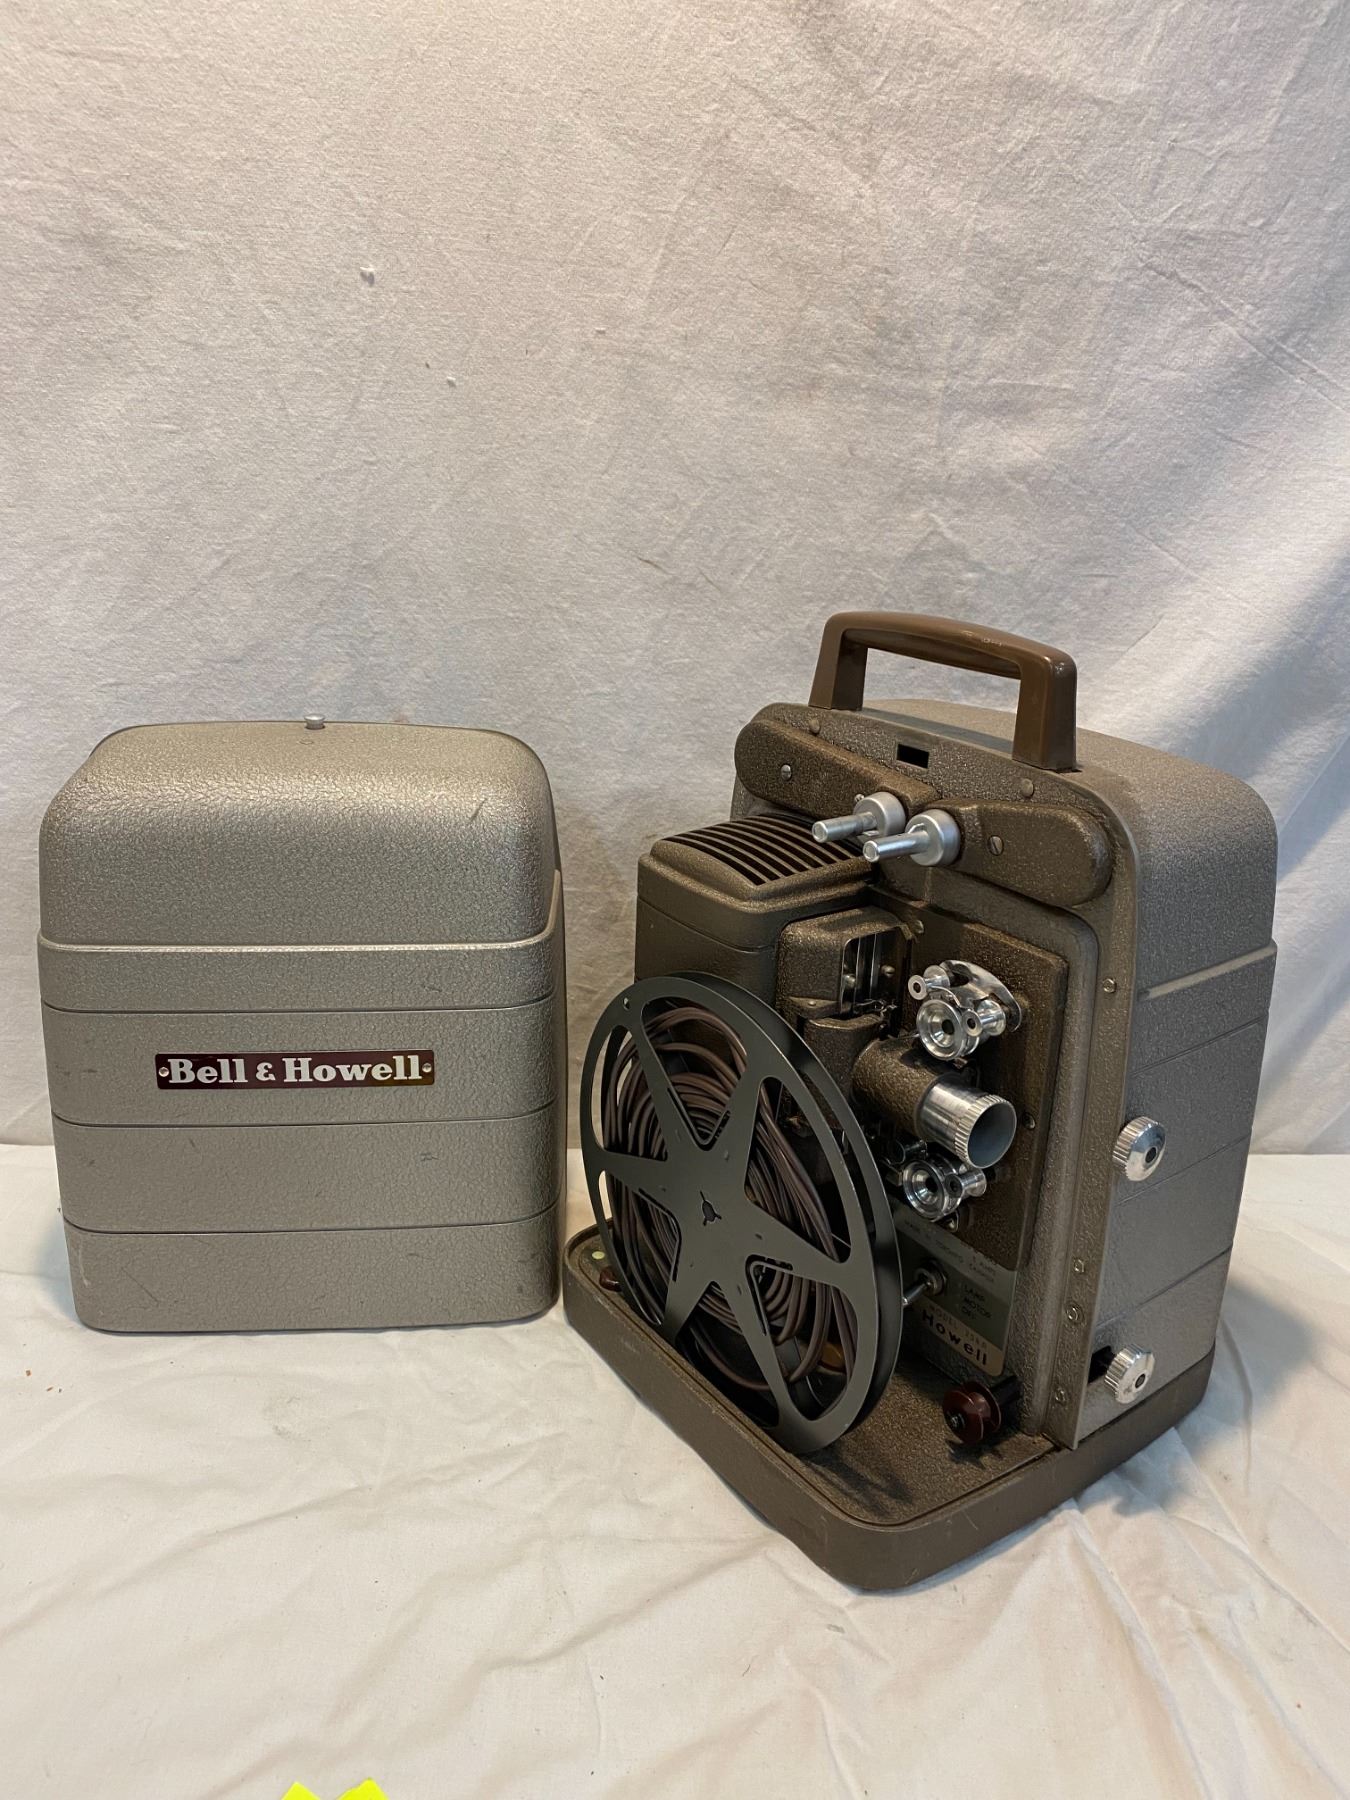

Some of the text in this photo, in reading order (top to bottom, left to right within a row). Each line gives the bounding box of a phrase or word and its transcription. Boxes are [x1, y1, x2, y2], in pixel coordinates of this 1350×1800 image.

[167, 1055, 423, 1084] Bell & Howell
[922, 1308, 987, 1366] Howell
